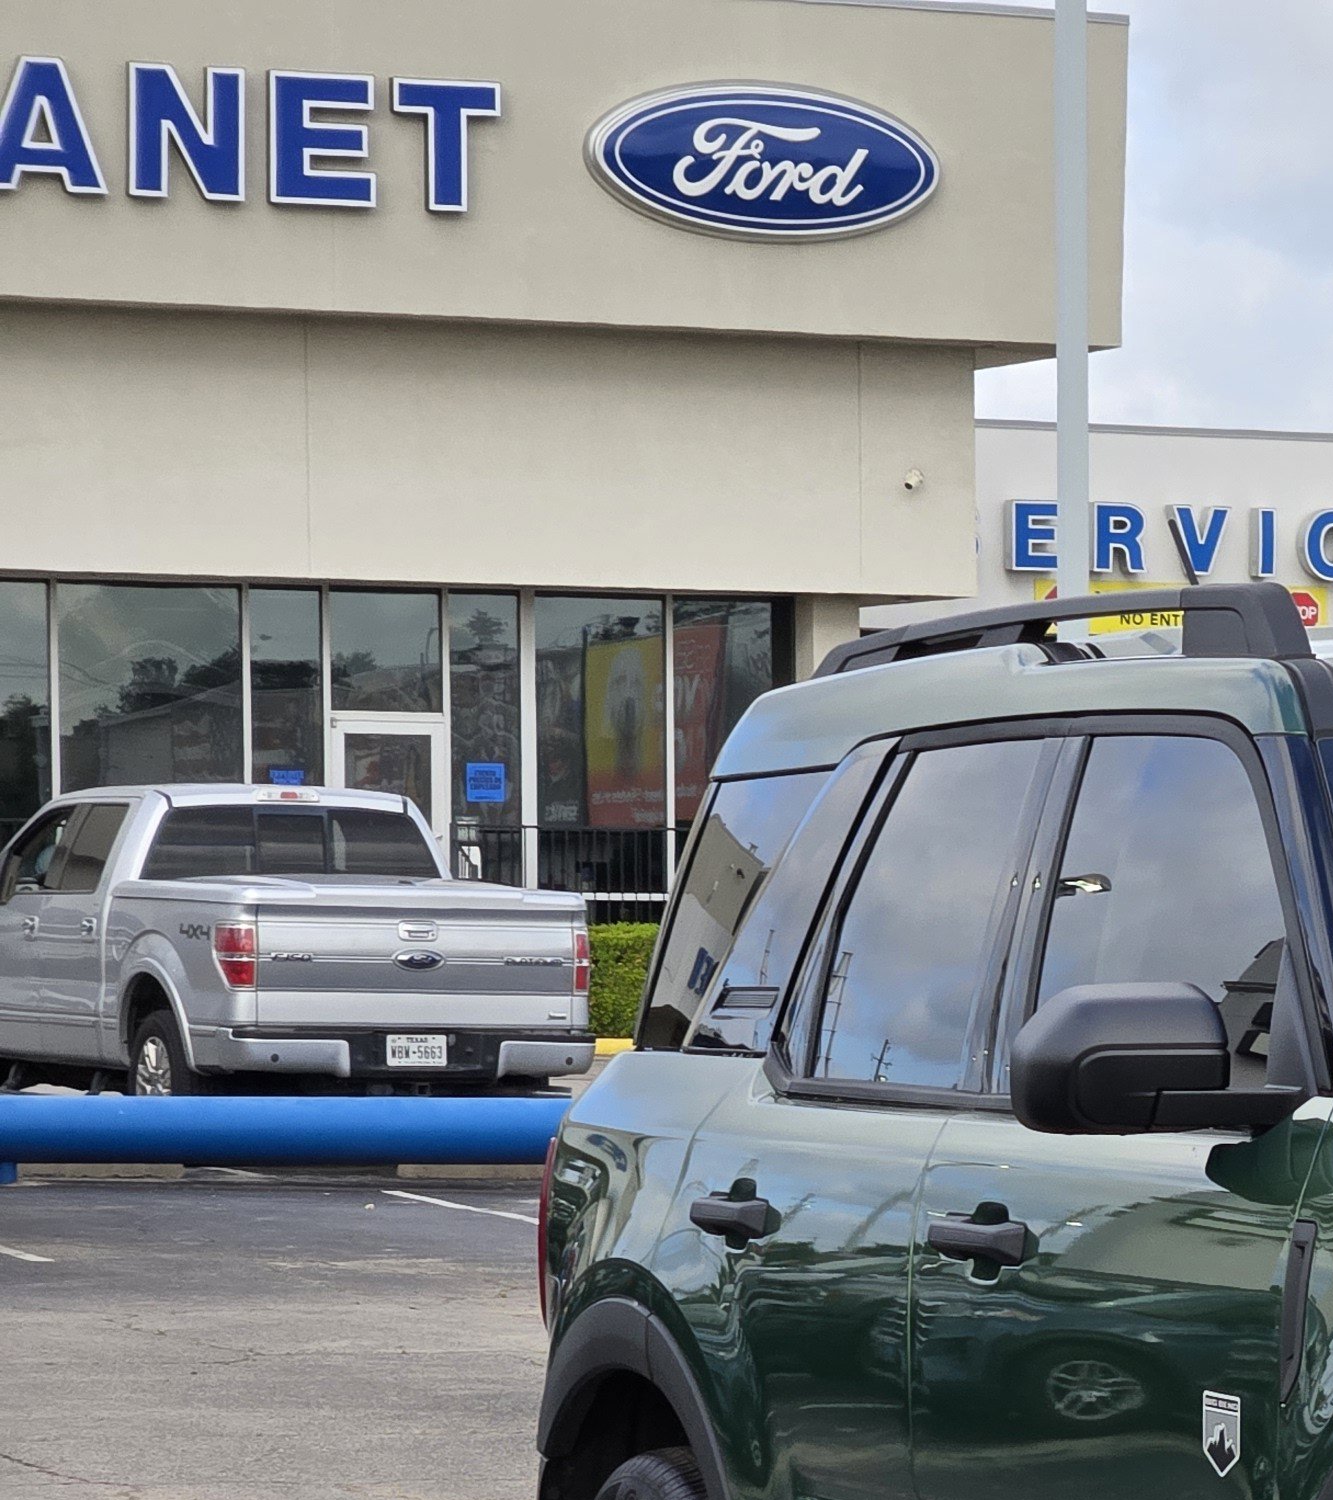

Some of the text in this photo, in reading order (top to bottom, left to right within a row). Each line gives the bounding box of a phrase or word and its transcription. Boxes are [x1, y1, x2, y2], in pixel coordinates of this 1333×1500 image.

[672, 116, 870, 207] Ford
[1119, 612, 1144, 626] NO
[1298, 605, 1318, 620] OP
[406, 1036, 429, 1044] TEXAS
